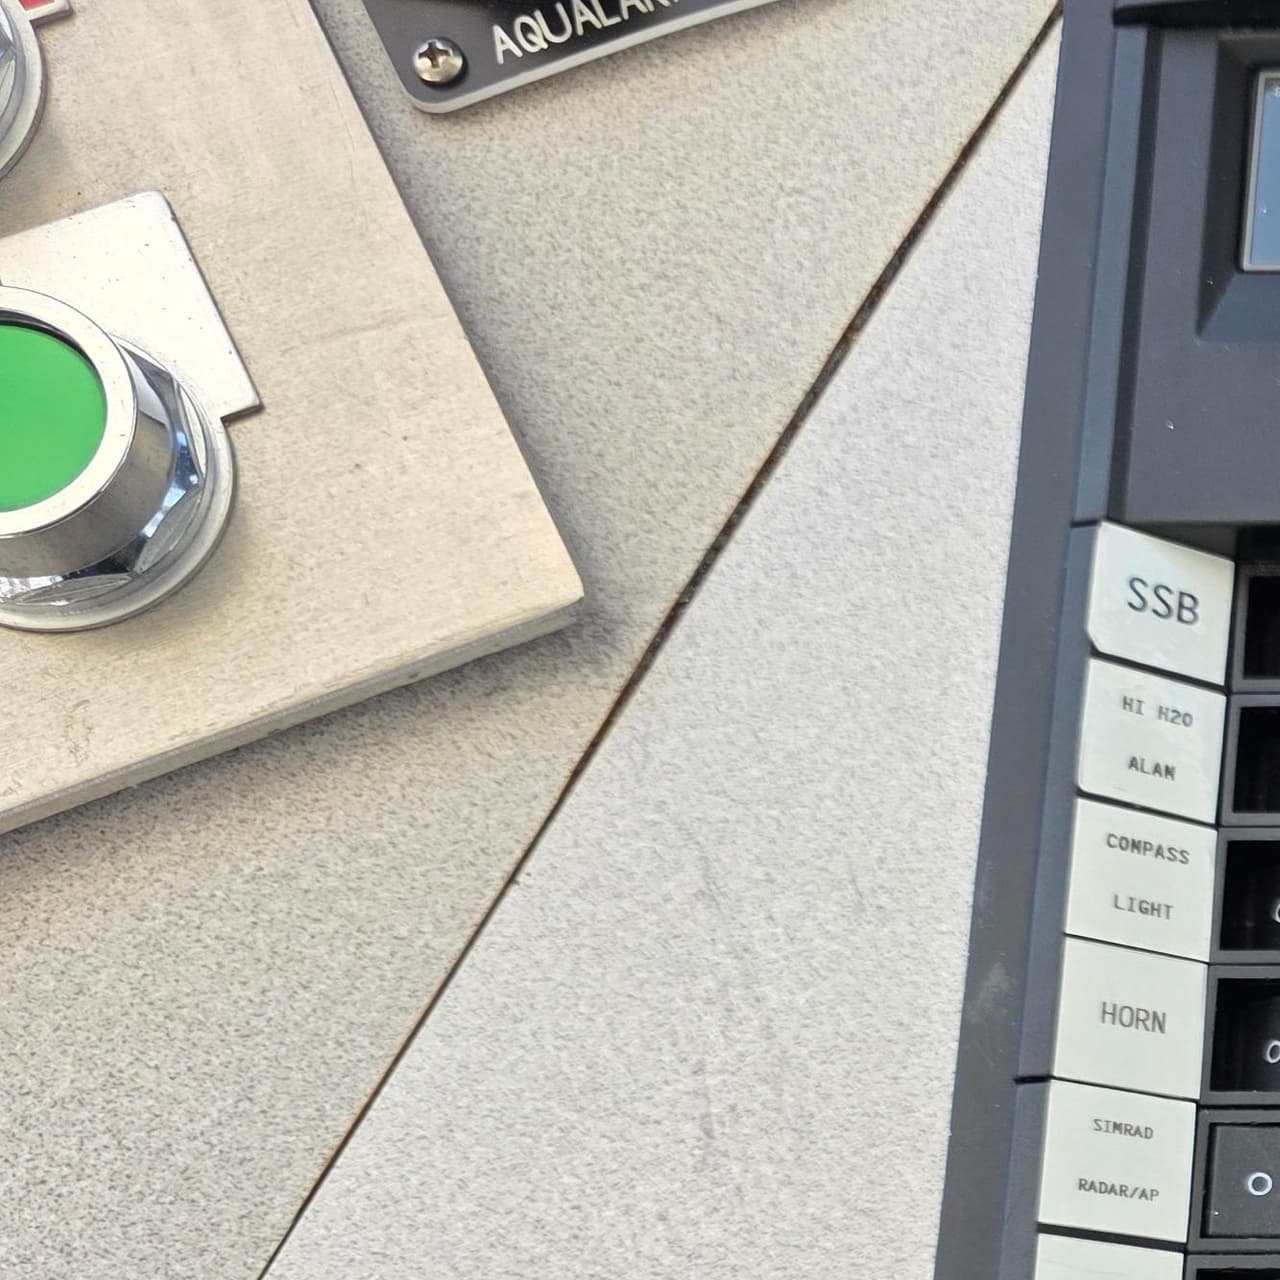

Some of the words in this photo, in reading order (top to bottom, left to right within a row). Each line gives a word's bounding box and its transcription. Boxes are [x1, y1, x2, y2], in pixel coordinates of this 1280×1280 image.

[1126, 576, 1200, 626] SSB
[1122, 695, 1146, 716] HI
[1105, 831, 1191, 865] COMPASS
[1113, 893, 1175, 921] LIGHT
[1100, 1000, 1167, 1035] HORN
[1092, 1117, 1155, 1141] SIMRAD
[1077, 1176, 1161, 1202] RADAR/AP
